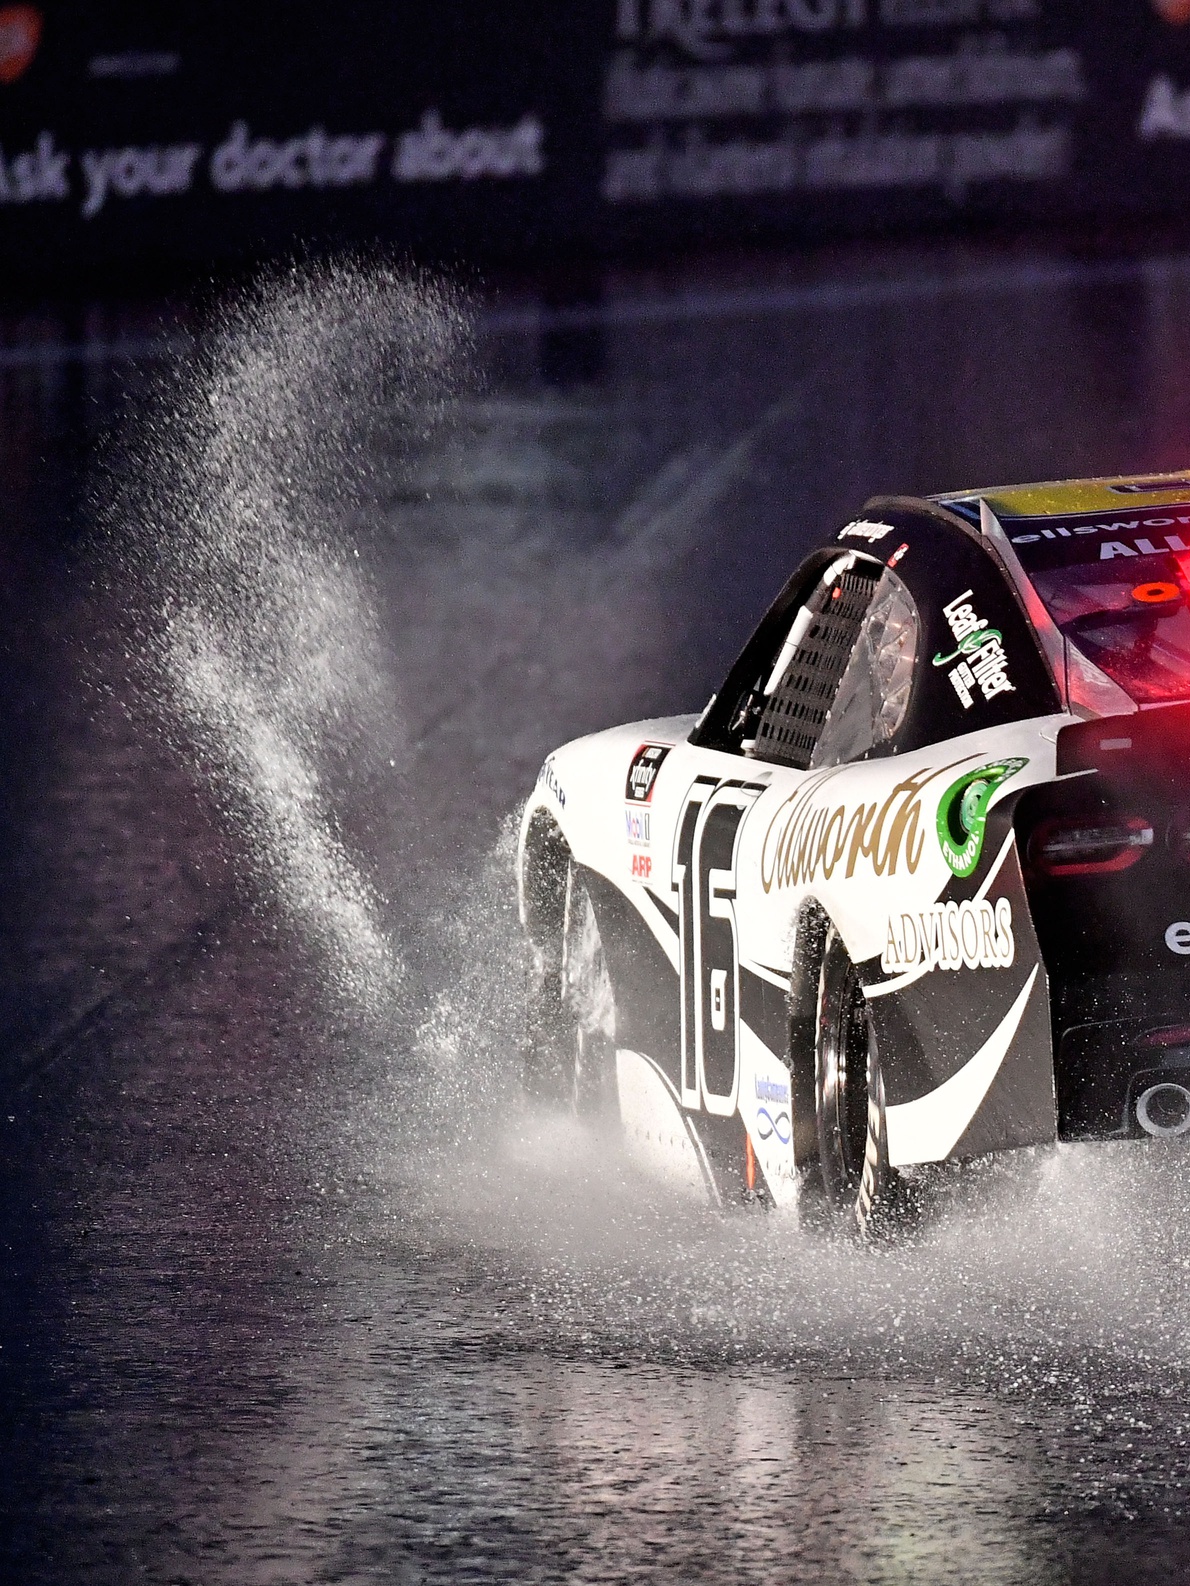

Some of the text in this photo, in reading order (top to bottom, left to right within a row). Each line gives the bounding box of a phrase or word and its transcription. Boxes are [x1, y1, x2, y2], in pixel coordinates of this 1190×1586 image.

[0, 130, 69, 202] sk
[82, 143, 200, 218] your
[210, 120, 384, 191] doctor
[393, 109, 544, 182] about
[631, 852, 653, 879] ARP
[942, 832, 980, 871] ETHANOL
[672, 774, 771, 1117] 16
[884, 905, 1012, 965] ADVISORS
